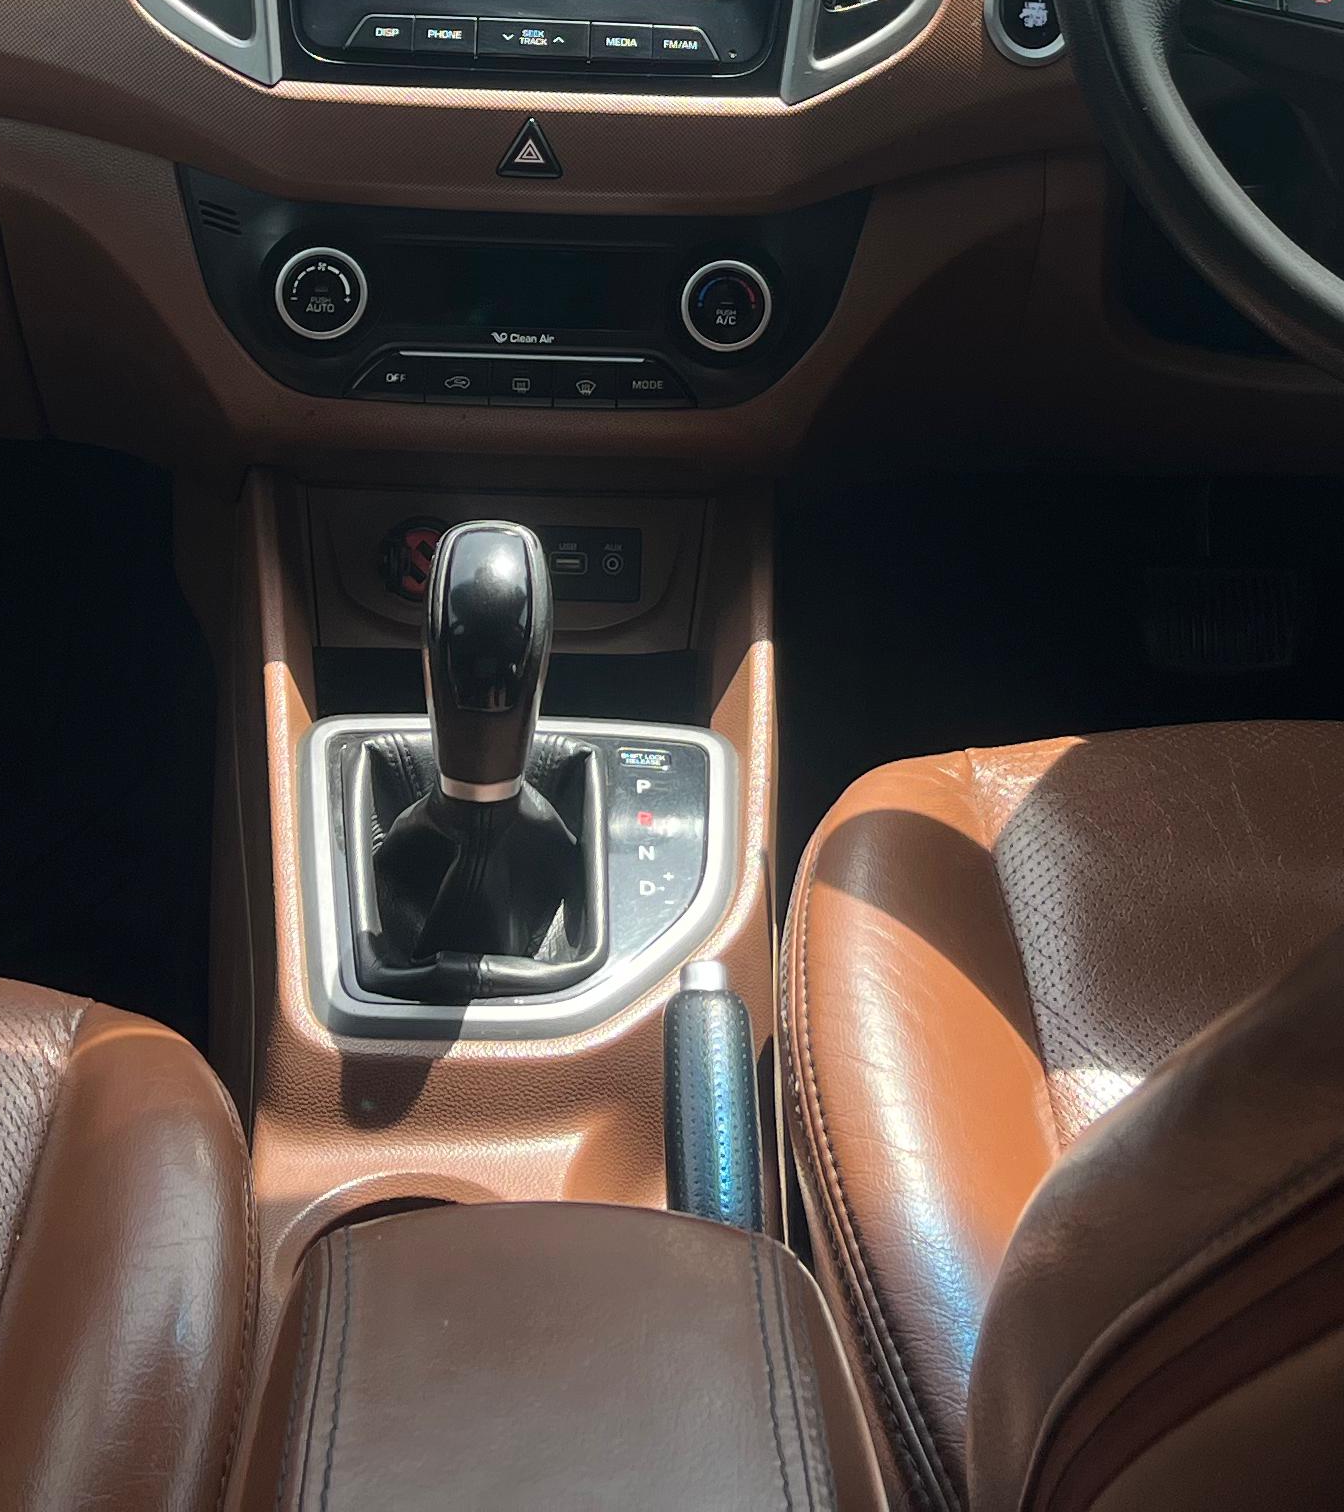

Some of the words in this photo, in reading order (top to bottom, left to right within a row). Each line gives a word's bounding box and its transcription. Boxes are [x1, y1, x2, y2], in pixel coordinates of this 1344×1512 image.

[375, 27, 400, 37] DISP
[427, 28, 462, 39] PHONE
[522, 30, 545, 38] SEEK
[519, 37, 548, 46] TRACK
[605, 37, 638, 48] MEDIA
[663, 39, 698, 51] FM/AM
[305, 303, 335, 313] AUTO
[716, 315, 737, 326] A/C
[509, 333, 537, 344] Clean
[539, 333, 555, 344] Air
[385, 373, 406, 383] OFF
[632, 379, 664, 390] MODE
[604, 543, 623, 551] AUX
[636, 779, 652, 795] P
[638, 845, 655, 861] N
[639, 880, 656, 896] D
